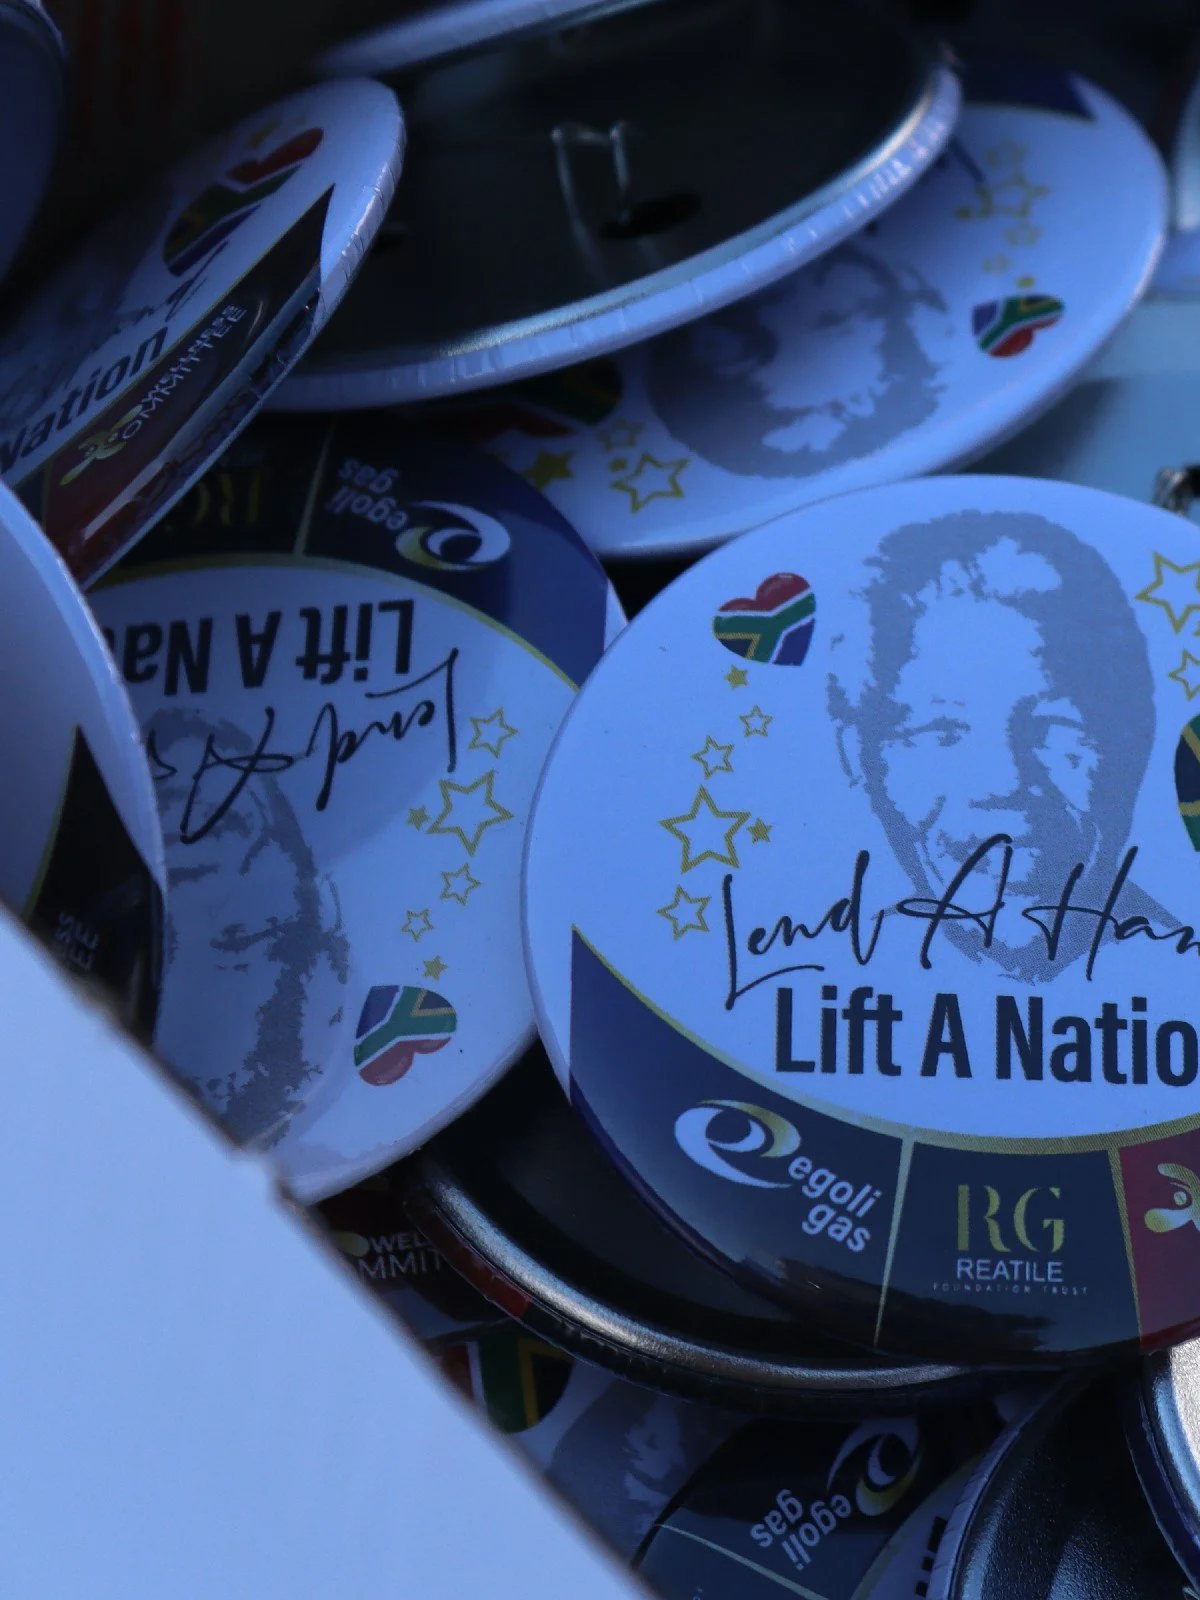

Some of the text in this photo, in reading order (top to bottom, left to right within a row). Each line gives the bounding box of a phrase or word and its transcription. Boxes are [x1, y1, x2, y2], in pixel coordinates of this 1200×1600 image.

[324, 485, 408, 530] egoli
[235, 611, 282, 690] A
[295, 600, 413, 684] Lift
[723, 848, 884, 1010] Lend
[893, 833, 1012, 969] A
[775, 985, 903, 1077] Lift
[920, 992, 973, 1079] A
[787, 1155, 884, 1219] egoli
[956, 1183, 1067, 1254] RG
[801, 1203, 872, 1254] gas
[955, 1257, 1066, 1284] REATILE
[749, 1488, 803, 1549] gas
[780, 1494, 852, 1572] egoli
